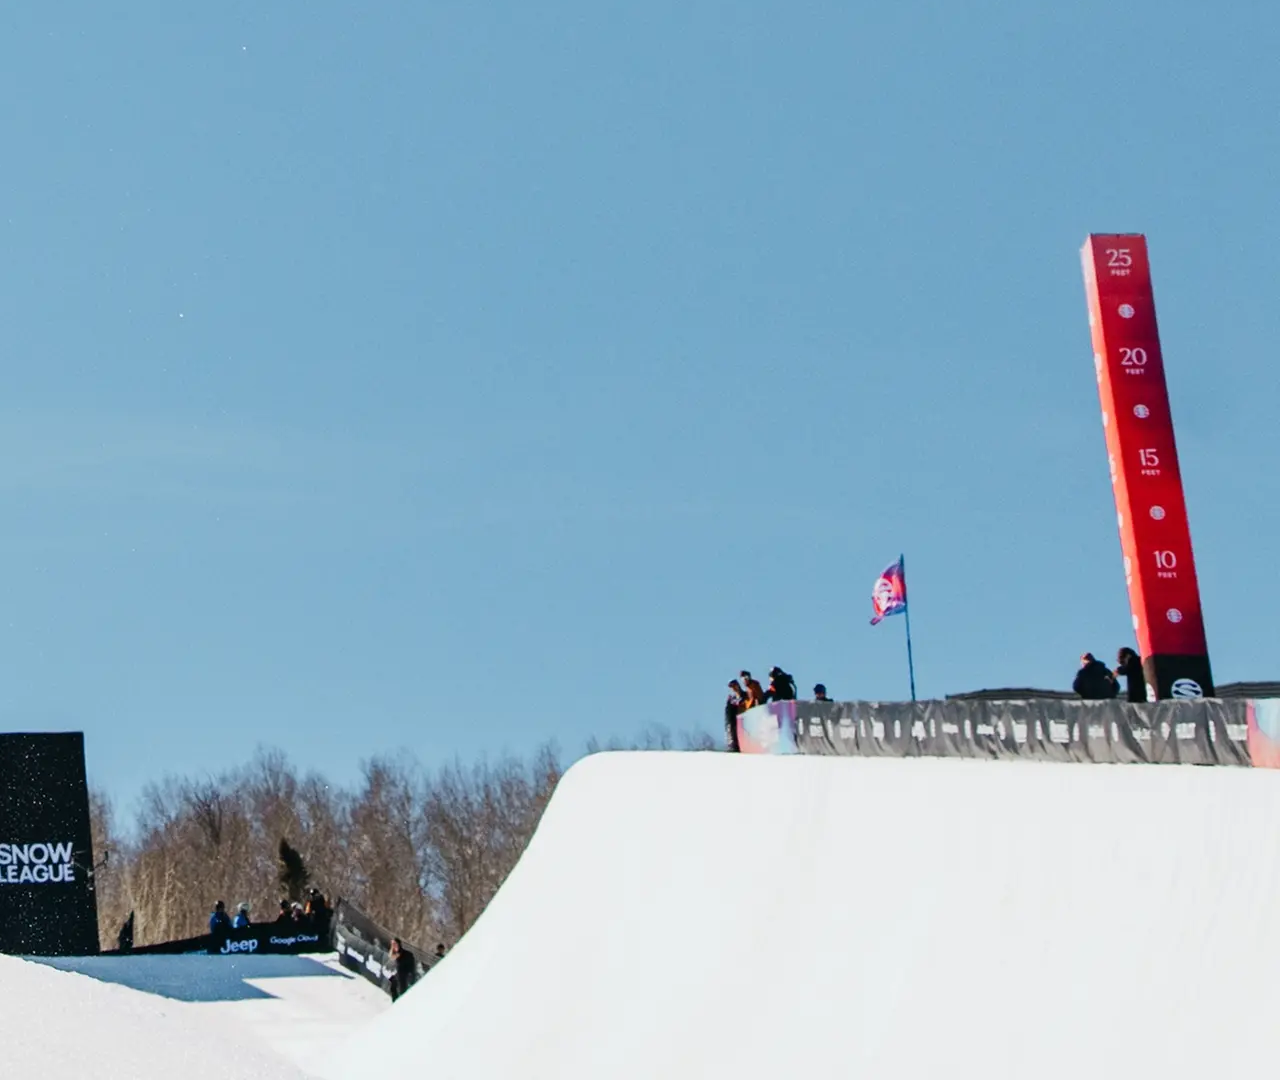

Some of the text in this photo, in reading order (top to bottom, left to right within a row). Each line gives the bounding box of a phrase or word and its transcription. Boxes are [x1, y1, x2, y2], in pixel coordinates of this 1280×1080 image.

[1105, 248, 1133, 267] 25
[1118, 347, 1148, 366] 20
[1138, 448, 1160, 467] 15
[1153, 550, 1177, 569] 10
[220, 937, 259, 954] Jeep
